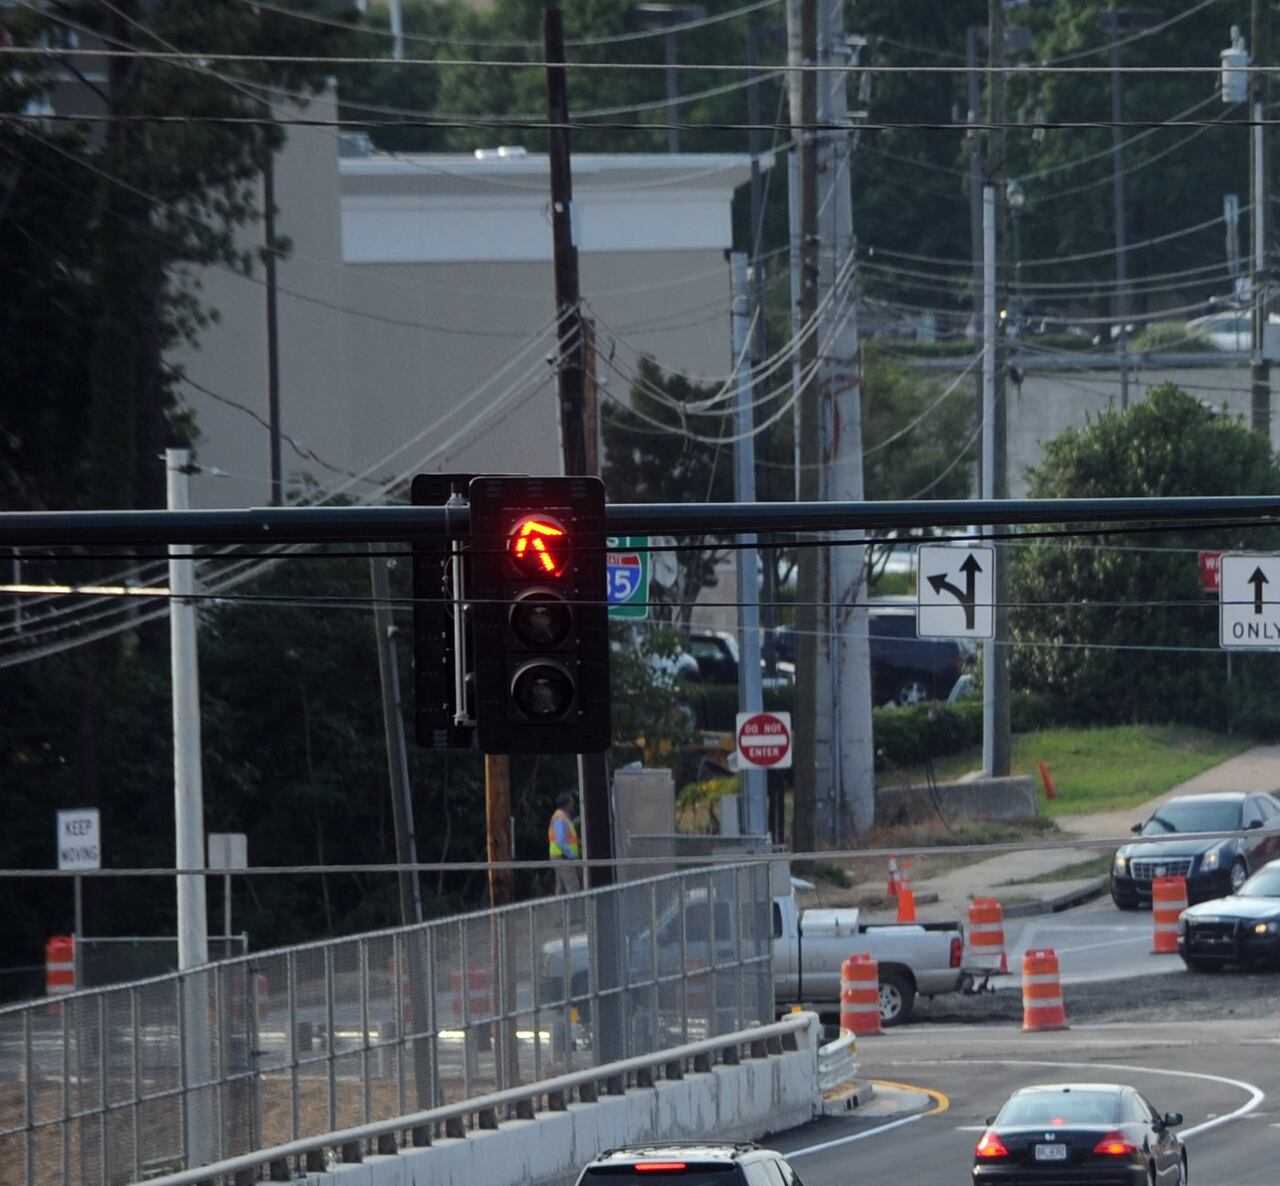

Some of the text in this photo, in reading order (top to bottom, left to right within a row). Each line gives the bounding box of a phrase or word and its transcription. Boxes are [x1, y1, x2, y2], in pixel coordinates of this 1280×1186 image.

[744, 722, 782, 735] DO NOT
[749, 747, 780, 758] ENTER
